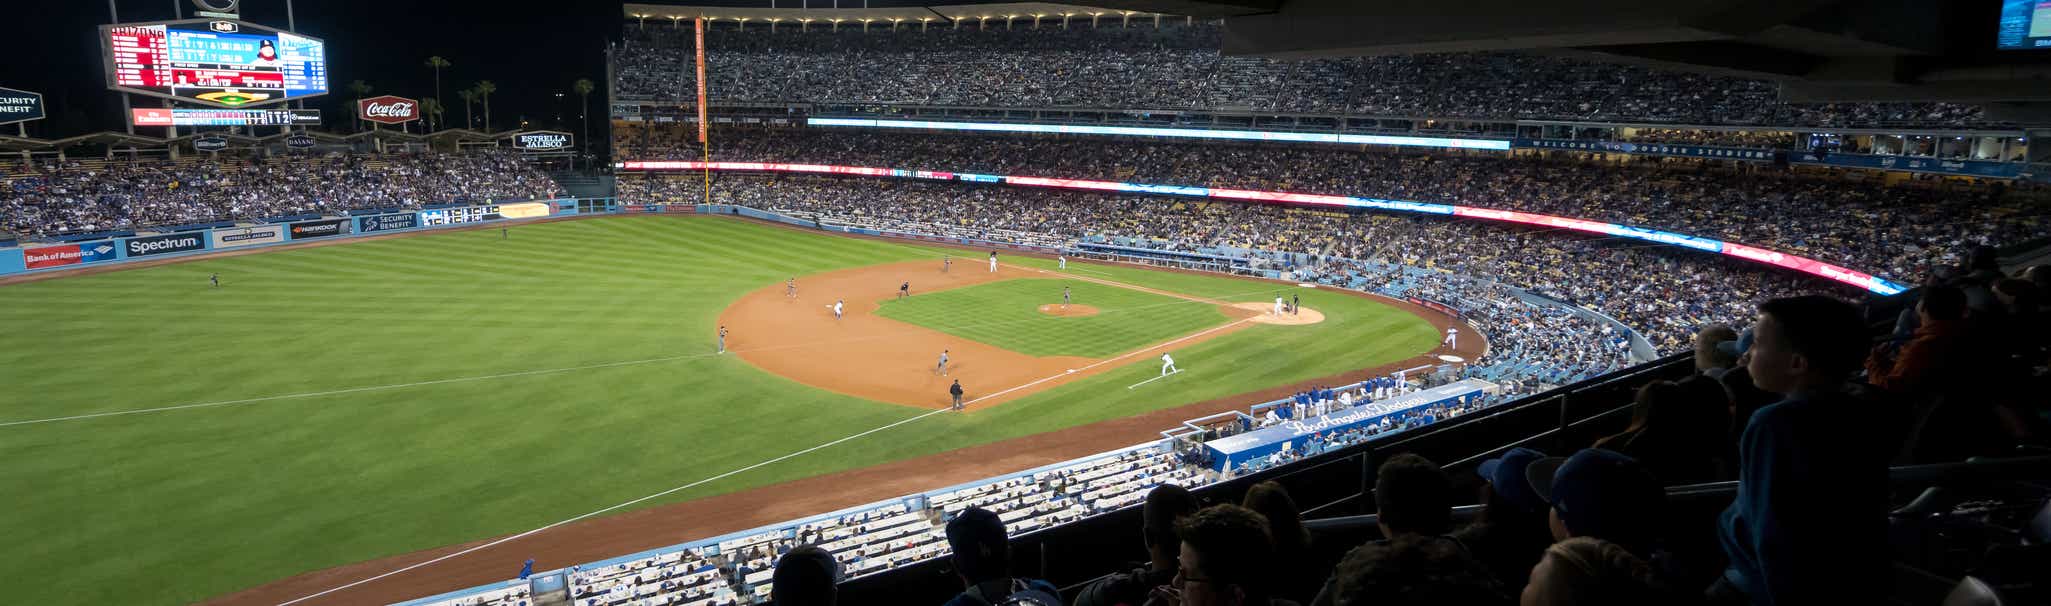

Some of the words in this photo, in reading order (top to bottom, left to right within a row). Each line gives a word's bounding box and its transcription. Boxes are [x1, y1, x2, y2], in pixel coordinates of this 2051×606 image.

[130, 237, 196, 253] Spectrum
[27, 253, 50, 262] Bank
[50, 252, 59, 260] of
[60, 250, 94, 259] America
